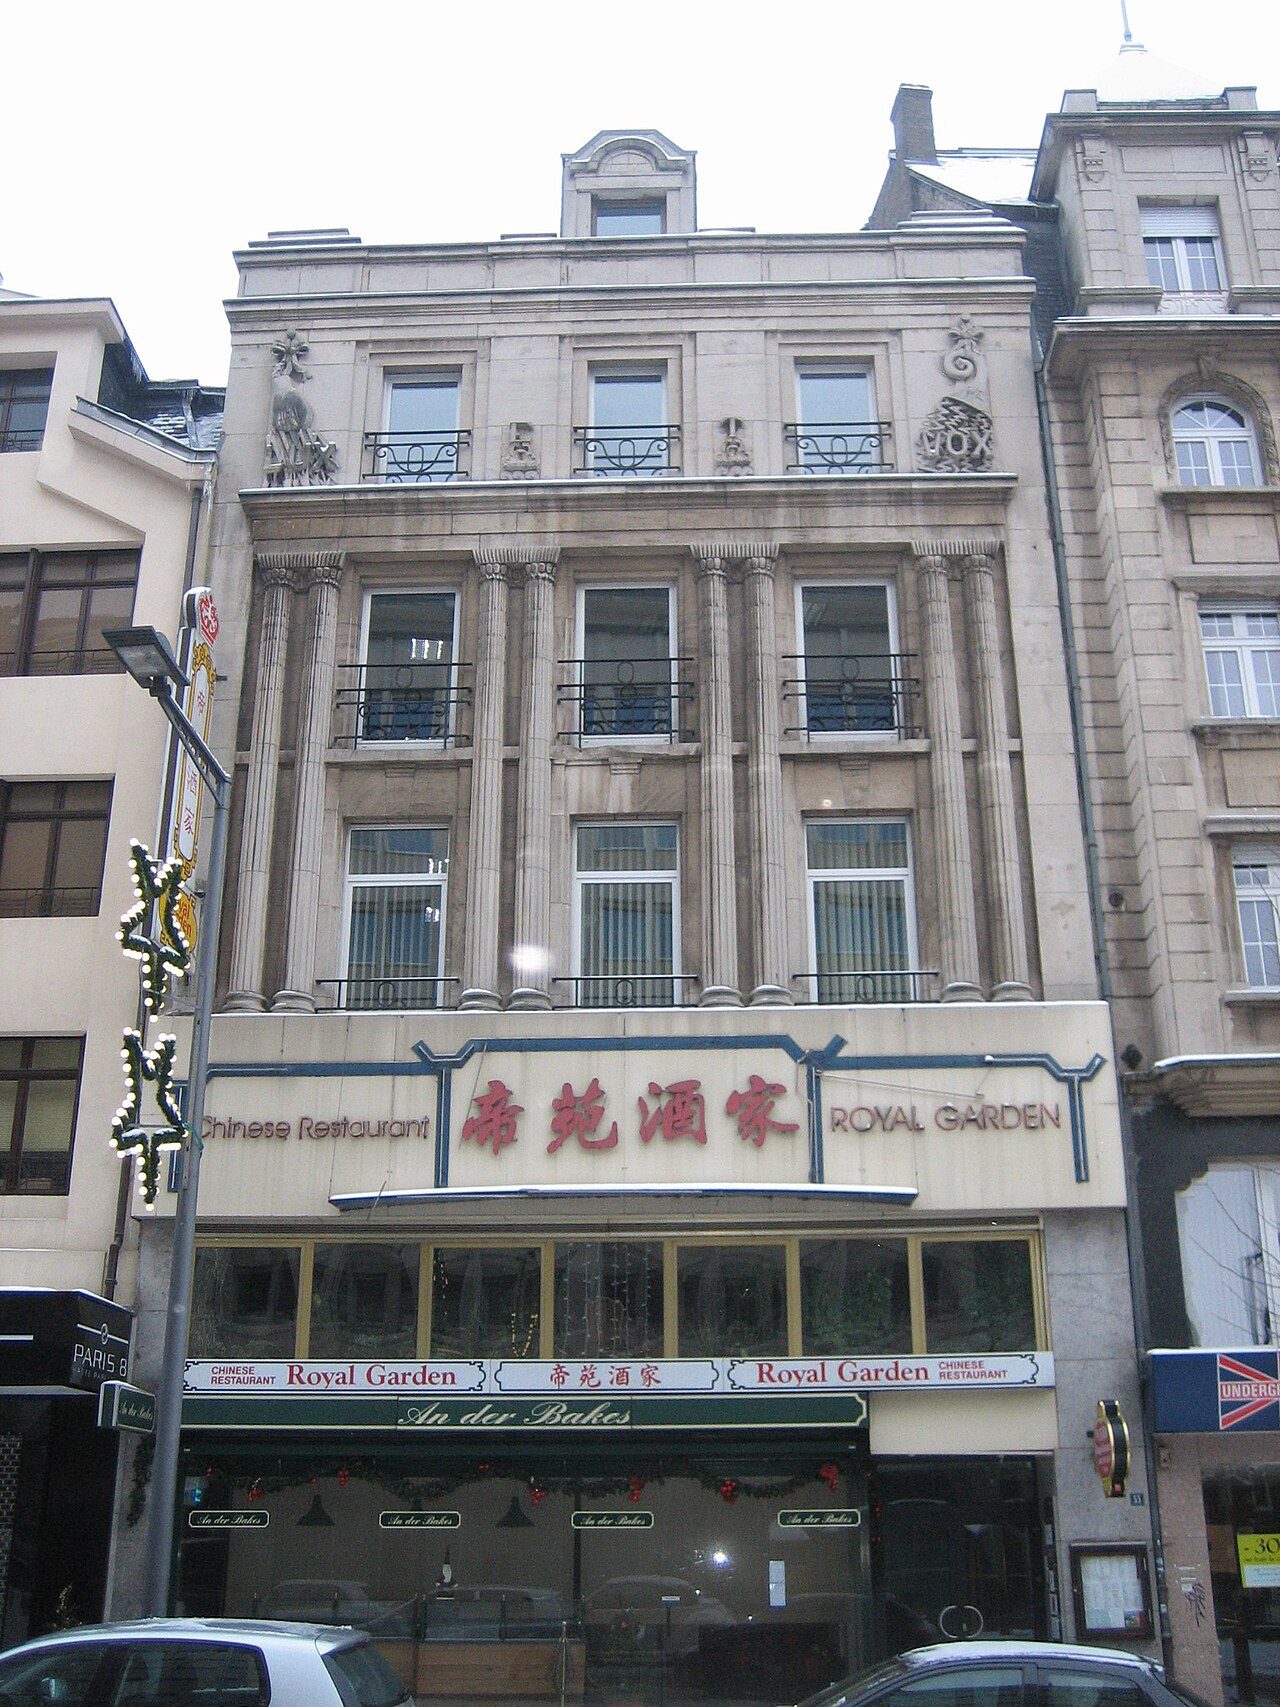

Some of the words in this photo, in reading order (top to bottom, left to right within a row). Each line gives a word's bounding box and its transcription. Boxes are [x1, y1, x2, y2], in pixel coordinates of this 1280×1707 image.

[920, 429, 992, 458] VOX
[461, 1074, 800, 1155] 帝苑酒家
[830, 1105, 926, 1133] ROYAL
[934, 1102, 1061, 1131] GARDEN
[201, 1115, 291, 1140] Chinese
[298, 1115, 431, 1140] Restaurant
[74, 1343, 116, 1373] PARIS
[119, 1358, 127, 1377] 8
[939, 1361, 985, 1370] CHINESE
[211, 1366, 255, 1375] CHINESE
[287, 1364, 356, 1389] Royal
[365, 1364, 456, 1386] Garden
[549, 1363, 662, 1389] 帝苑酒家
[757, 1362, 827, 1387] Royal
[838, 1360, 930, 1383] Garden
[939, 1370, 1008, 1380] RESTAURANT
[211, 1376, 276, 1385] RESTAURANT
[1222, 1383, 1280, 1398] UNDERG
[398, 1402, 450, 1424] An
[459, 1404, 516, 1425] der
[523, 1402, 630, 1425] Bakes
[213, 1514, 230, 1524] der
[404, 1515, 421, 1525] der
[597, 1516, 613, 1525] der
[803, 1514, 820, 1524] der
[1254, 1536, 1280, 1554] 30
